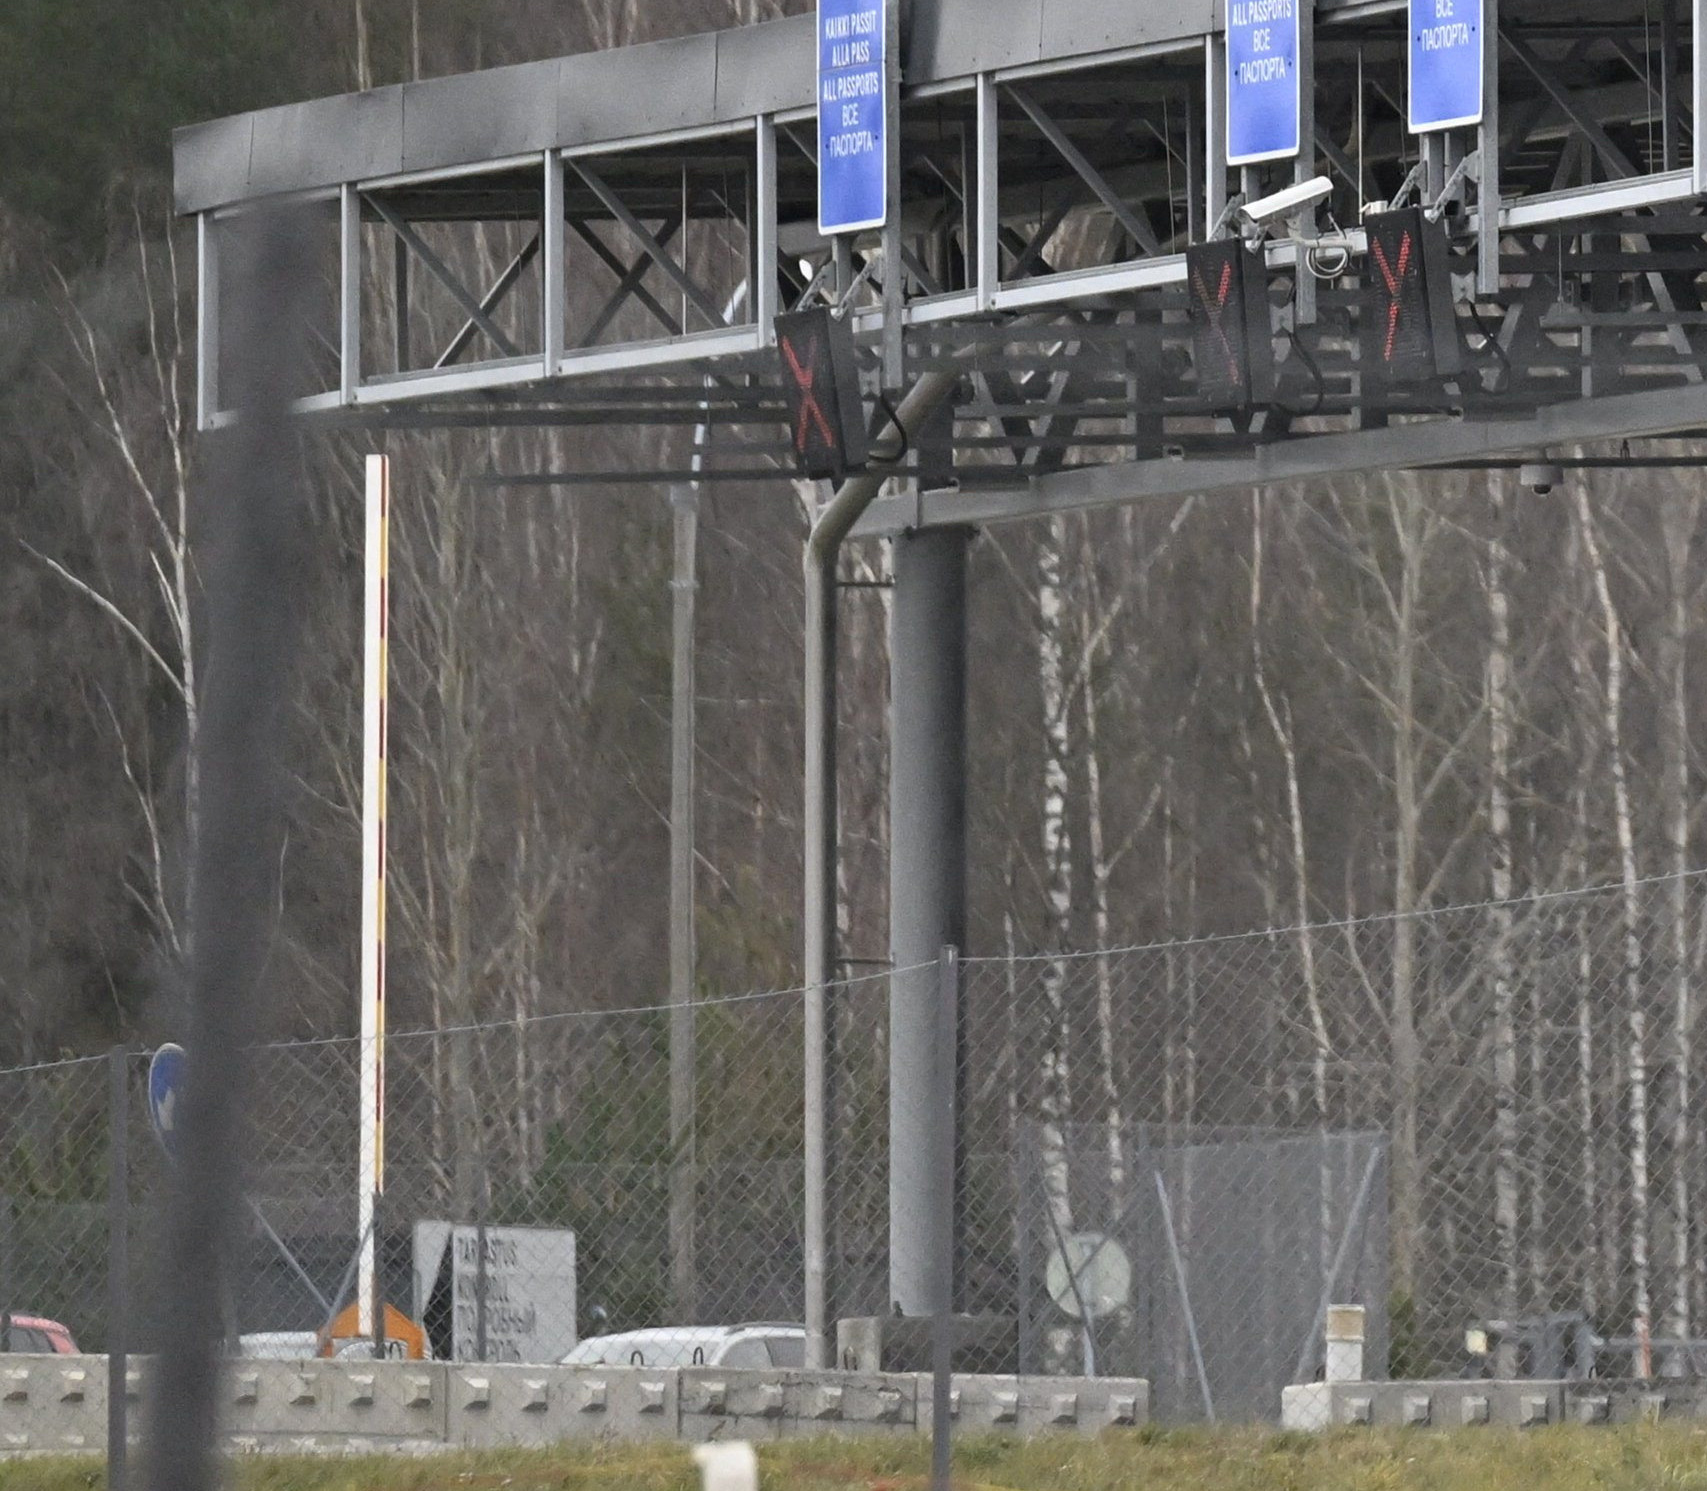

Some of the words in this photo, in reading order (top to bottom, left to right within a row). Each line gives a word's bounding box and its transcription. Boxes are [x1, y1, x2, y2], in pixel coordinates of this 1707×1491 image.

[825, 15, 850, 40] KAIKKI
[851, 10, 877, 36] PASSIT
[1232, 2, 1247, 26] ALL
[1252, 28, 1271, 52] ВСЕ
[1421, 22, 1469, 51] ПАСПОРТА
[832, 45, 850, 67] ALLA
[851, 41, 870, 64] PASS
[1240, 56, 1286, 85] ПАСПОРТА
[823, 79, 837, 101] ALL
[838, 71, 879, 99] PASSPORTS
[842, 103, 859, 127] ВСЕ
[829, 131, 873, 158] ПАСПОРТА
